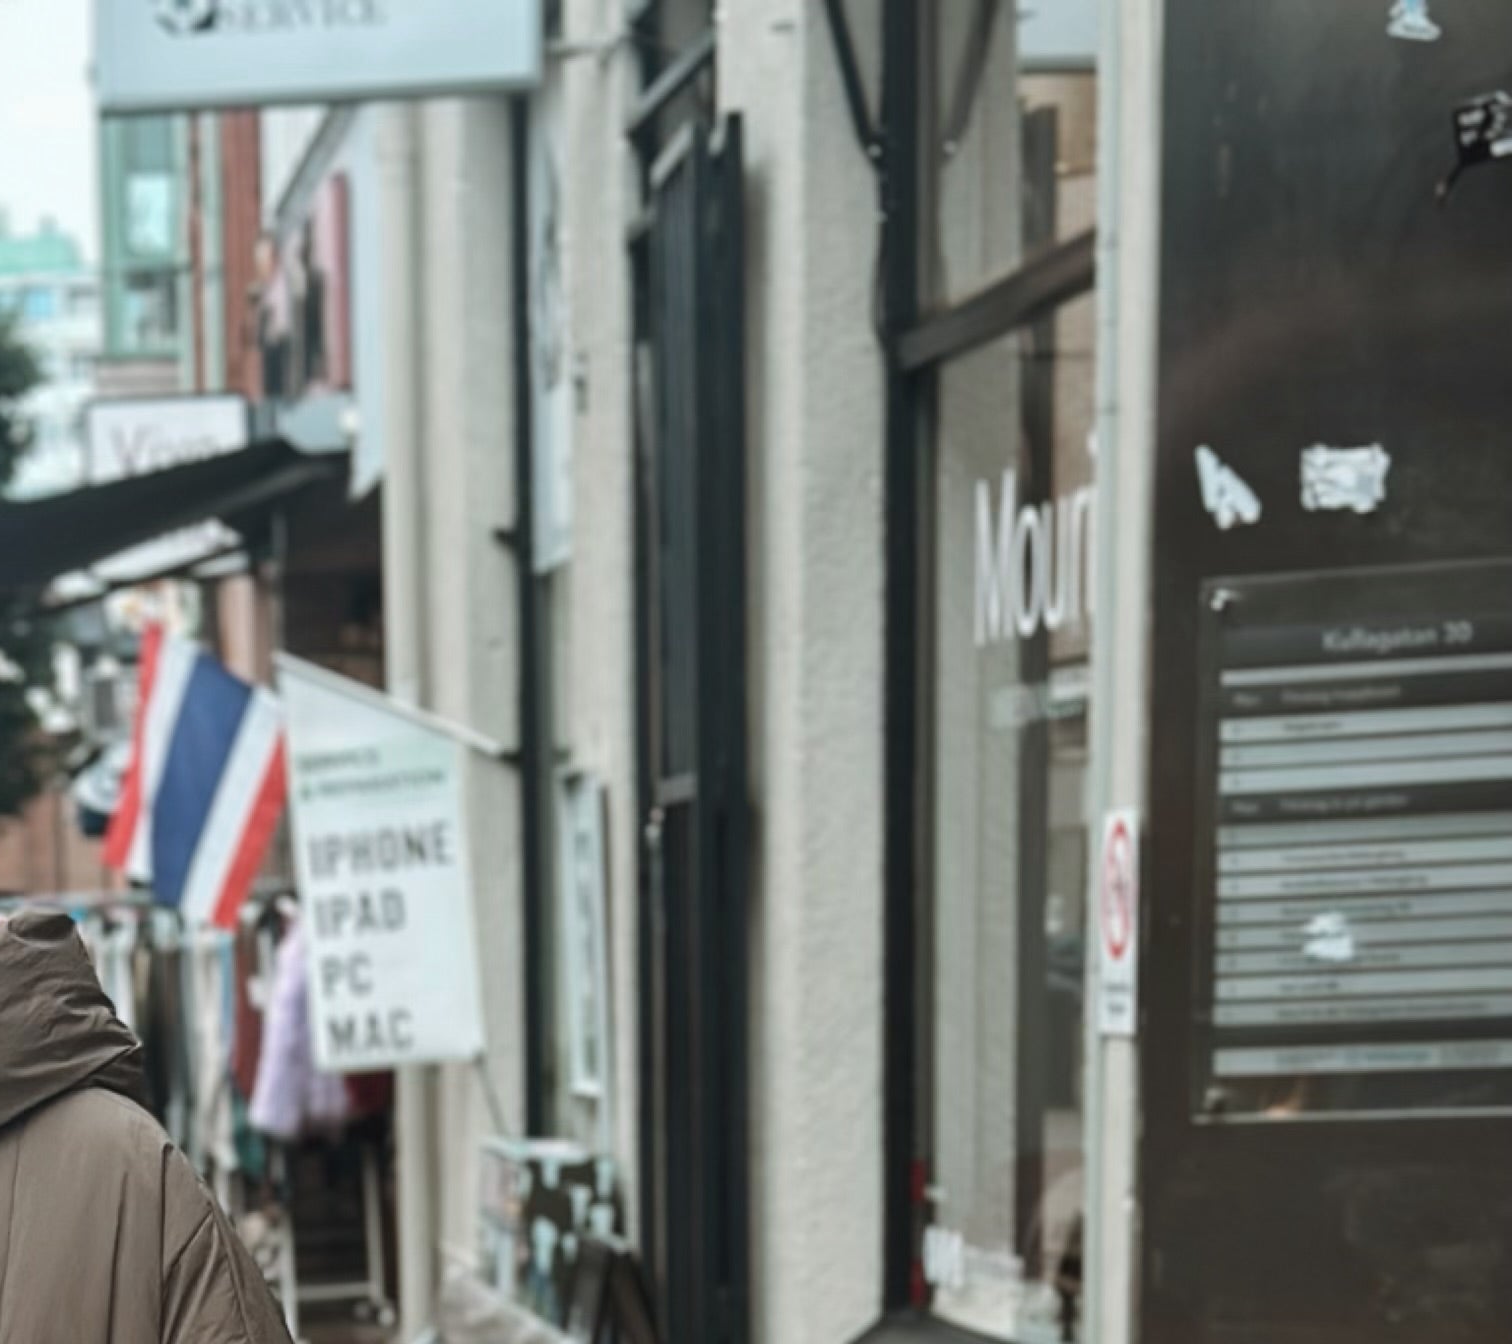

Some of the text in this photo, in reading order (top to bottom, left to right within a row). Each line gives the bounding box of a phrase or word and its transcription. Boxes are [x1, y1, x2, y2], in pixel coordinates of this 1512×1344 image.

[314, 886, 407, 939] IPAD
[321, 950, 374, 999] PC
[328, 1007, 414, 1053] MAC
